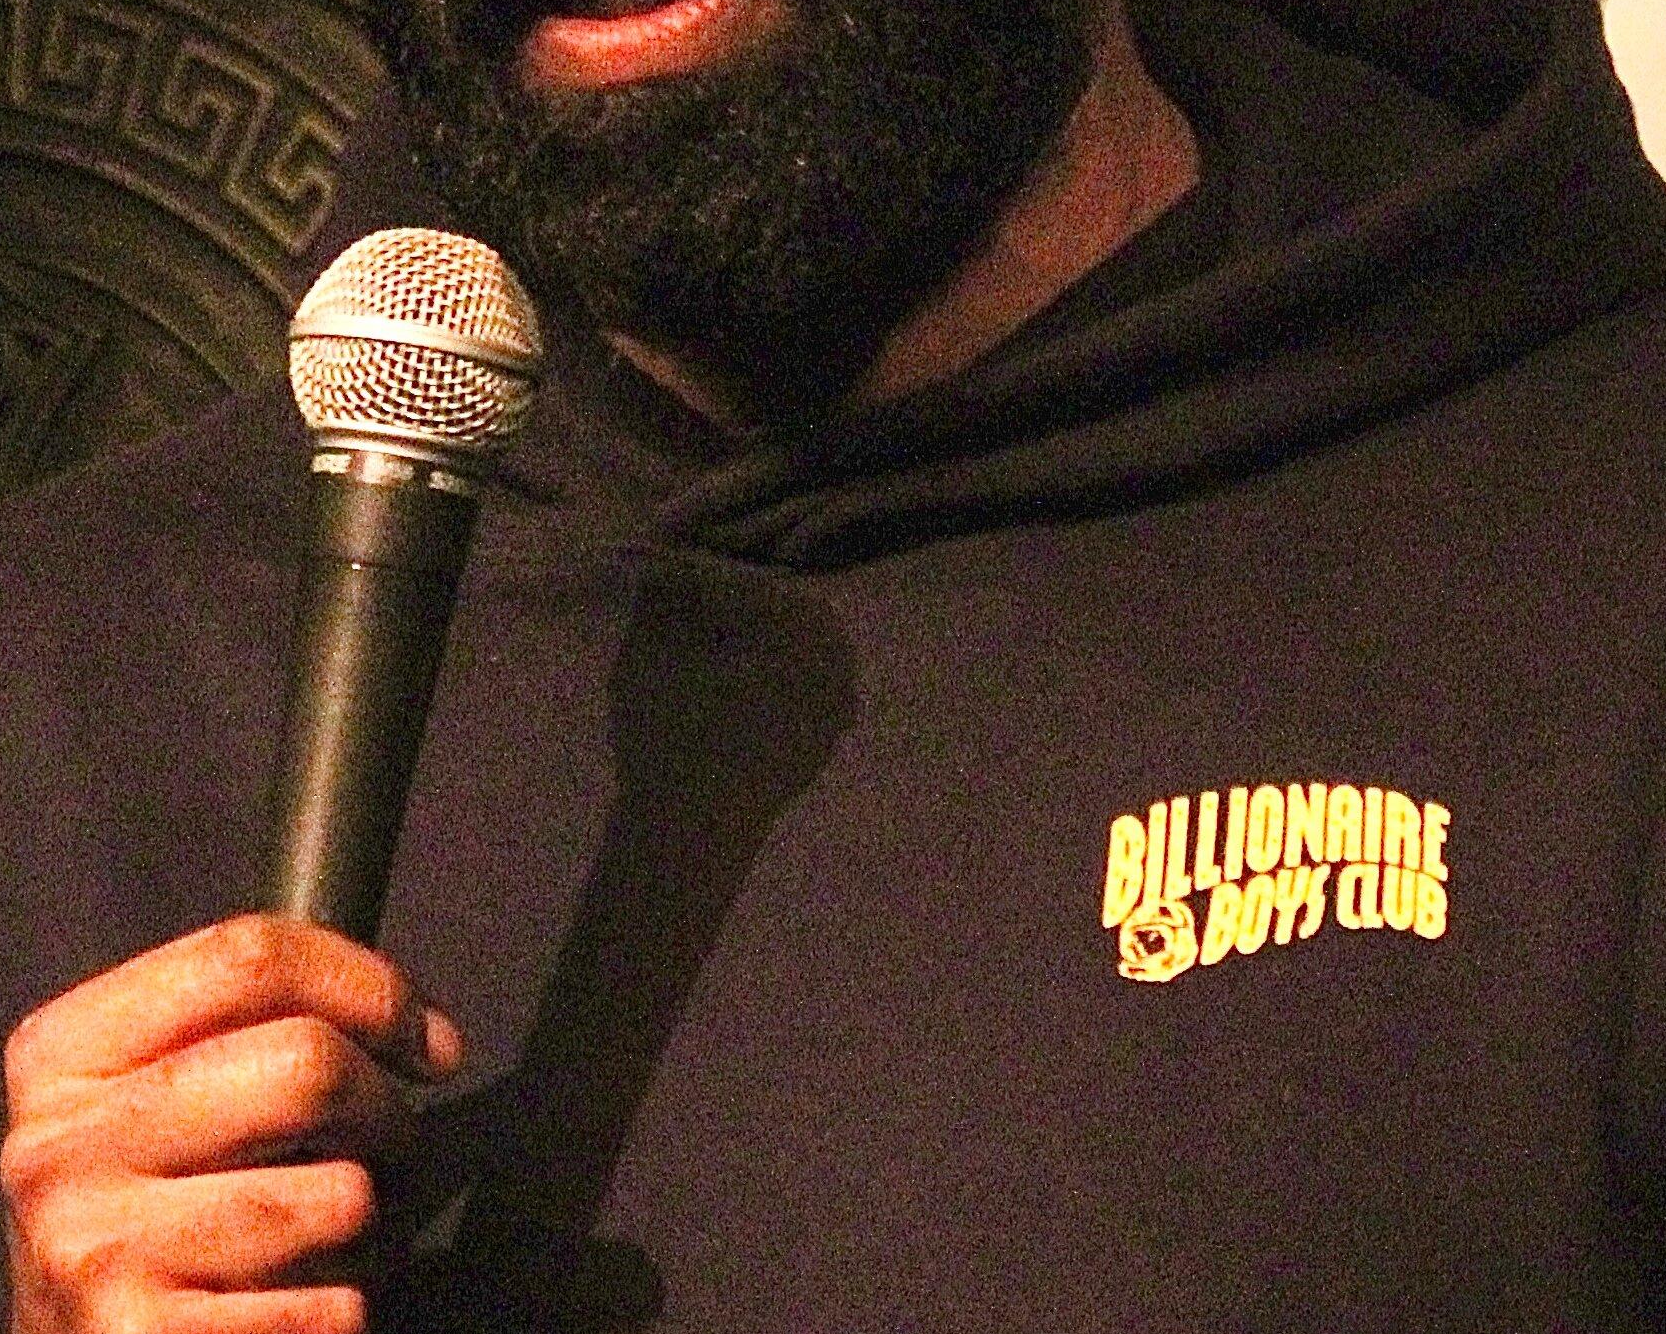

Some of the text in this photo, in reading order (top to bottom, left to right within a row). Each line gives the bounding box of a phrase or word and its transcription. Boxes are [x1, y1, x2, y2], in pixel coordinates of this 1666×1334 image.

[1102, 782, 1451, 929] BILLIONAIRE
[1200, 862, 1448, 966] BOYS CLUB
